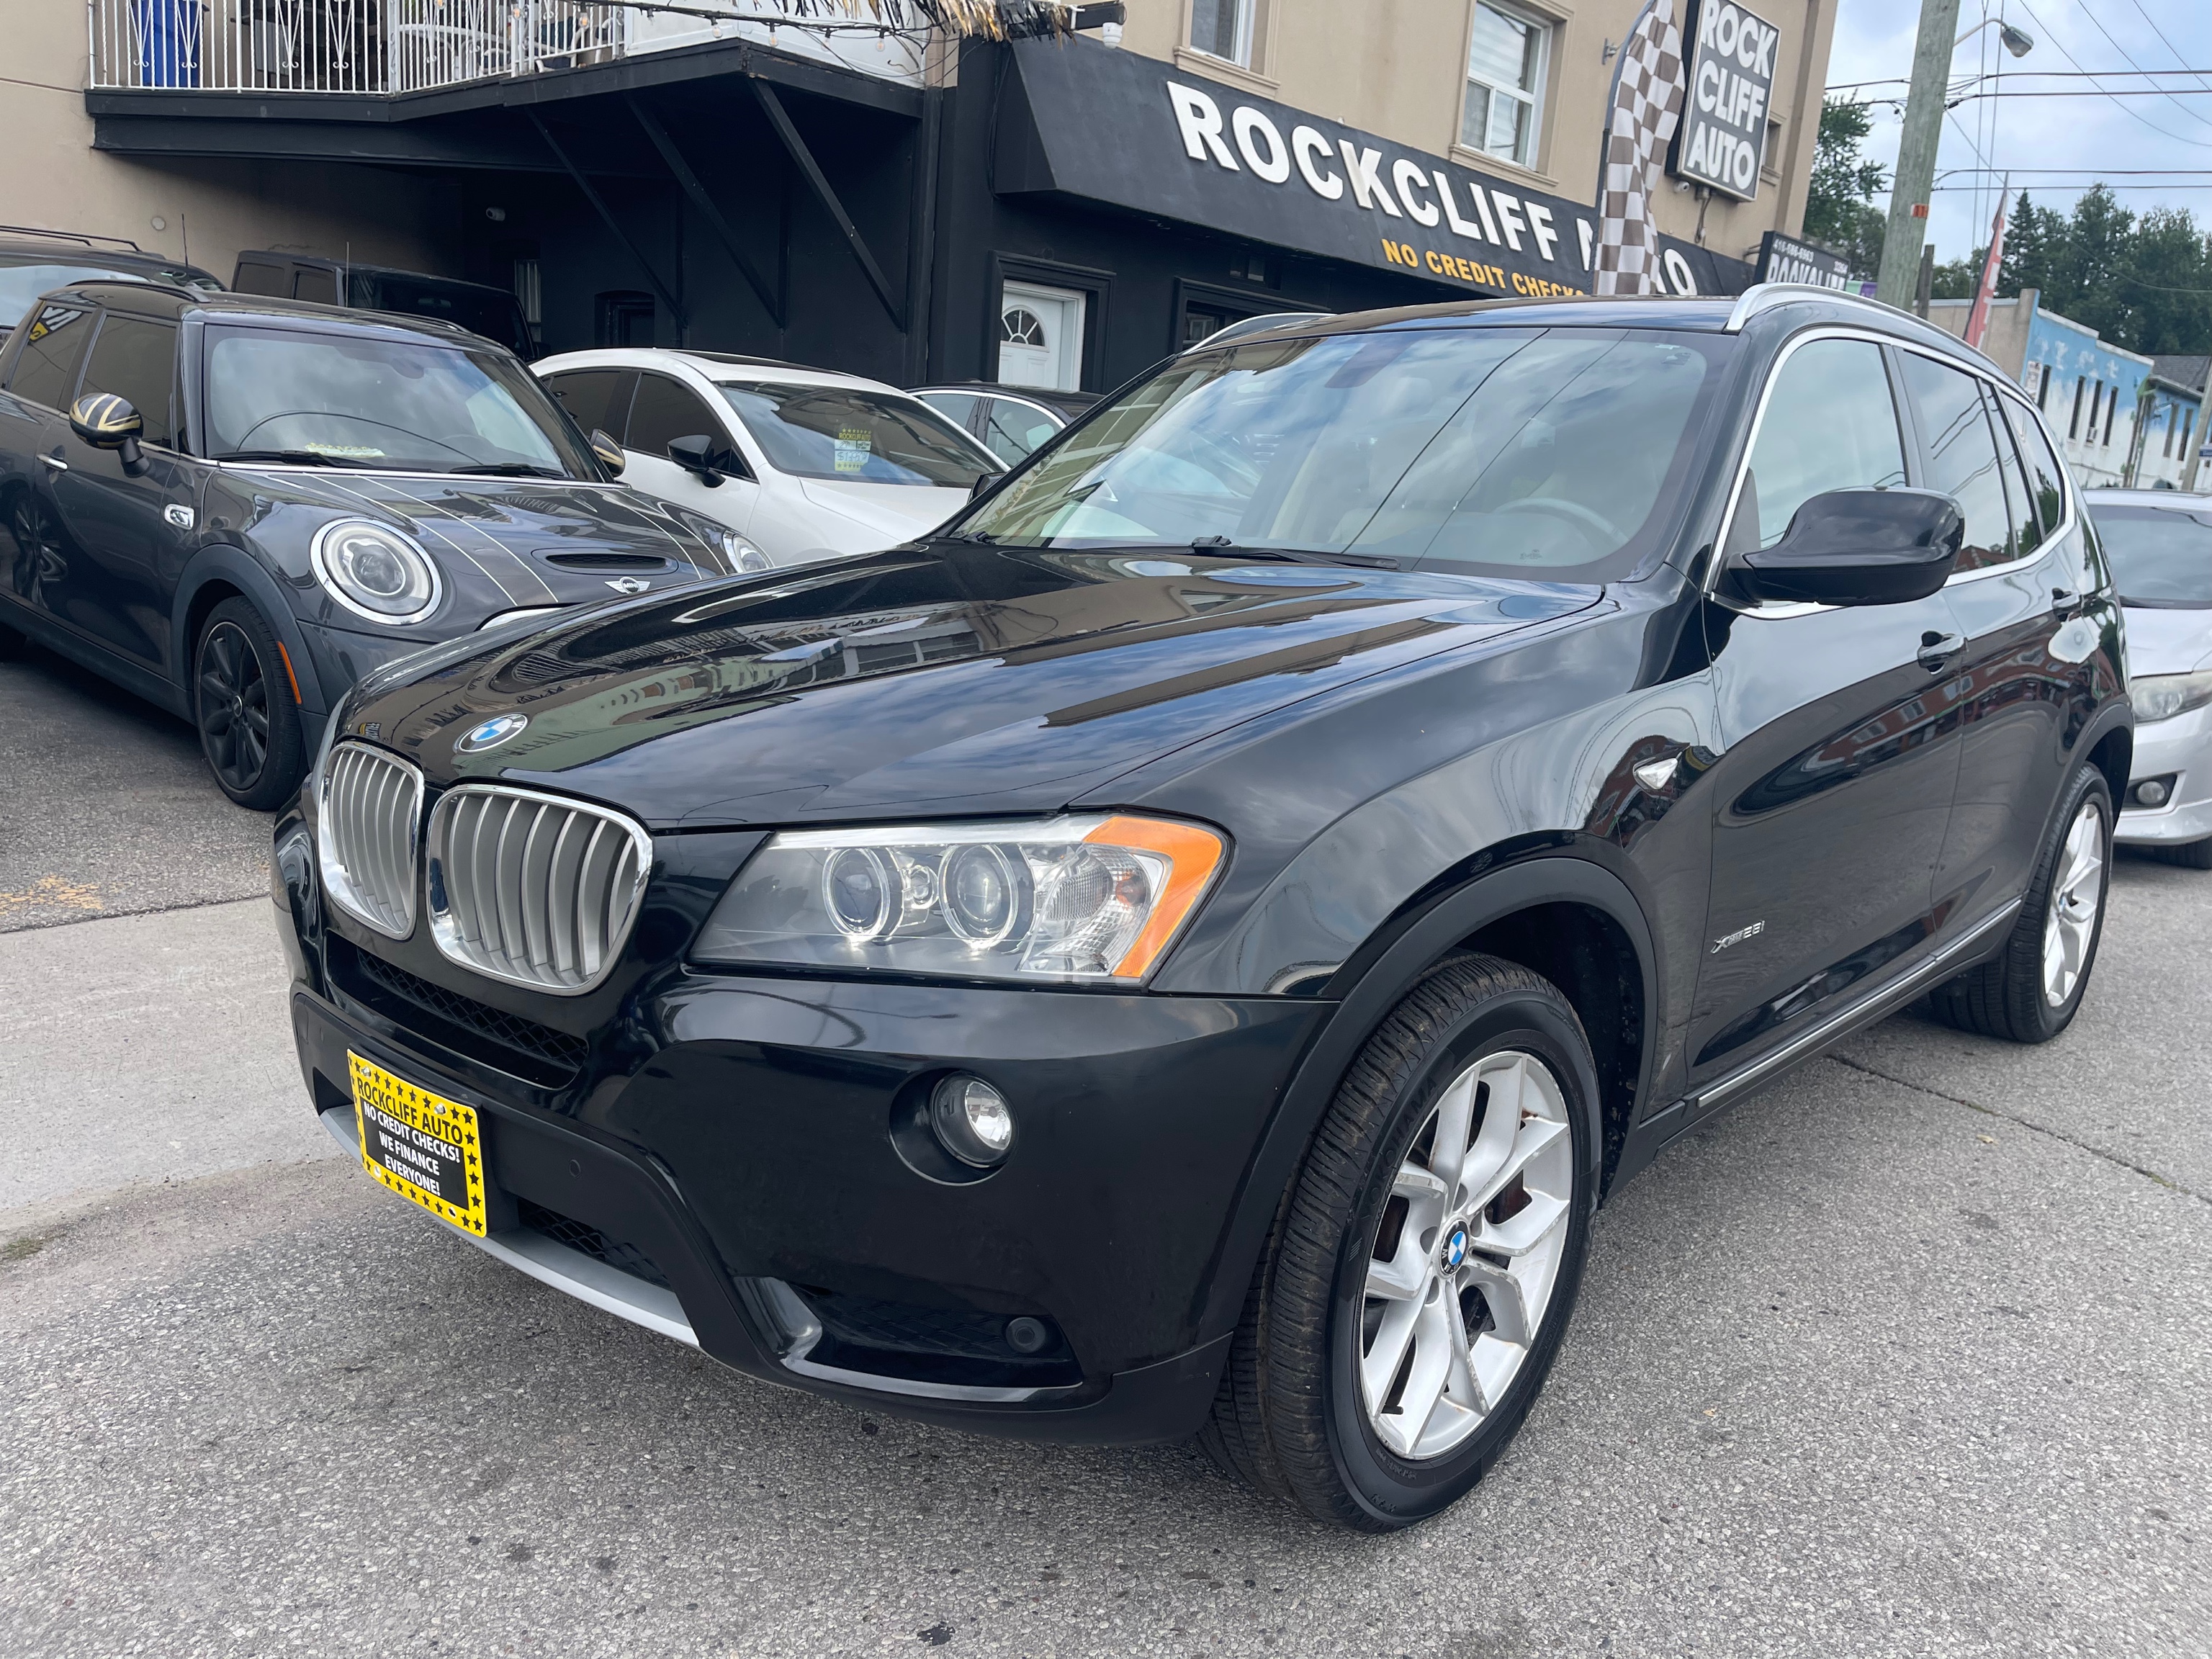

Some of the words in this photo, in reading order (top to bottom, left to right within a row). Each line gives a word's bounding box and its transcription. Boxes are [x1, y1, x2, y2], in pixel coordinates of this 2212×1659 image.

[1701, 0, 1777, 79] ROCK
[1697, 60, 1766, 133] CLIFF
[1166, 81, 1558, 261] ROCKCLIFF
[1686, 121, 1755, 190] AUTO
[1381, 238, 1419, 267] NO
[1425, 250, 1506, 289] CREDIT
[1511, 272, 1584, 297] CHEC
[357, 1077, 418, 1126] ROCKCLIFF
[422, 1112, 463, 1145] AUTO
[364, 1102, 377, 1121] NO
[378, 1111, 410, 1141] CREDIT
[412, 1130, 460, 1163] CHECKS!
[379, 1130, 395, 1153] WE
[395, 1143, 440, 1176] FINANCE
[385, 1154, 441, 1196] EVERYONE!
